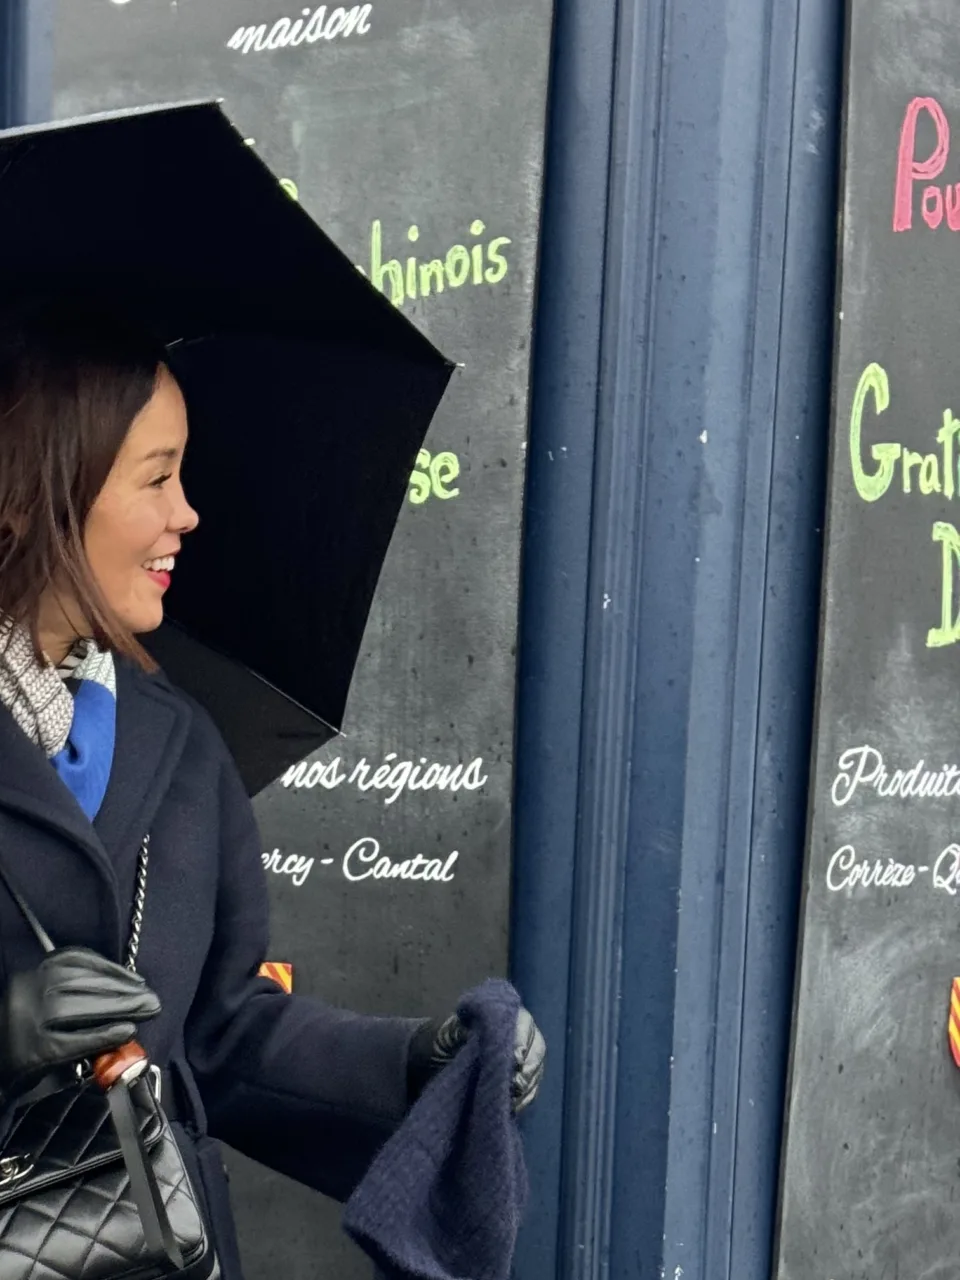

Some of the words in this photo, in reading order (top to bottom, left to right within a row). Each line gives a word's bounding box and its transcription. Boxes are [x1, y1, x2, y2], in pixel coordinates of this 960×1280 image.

[226, 3, 373, 54] maison
[356, 219, 512, 308] hinois
[280, 756, 346, 790] nos
[348, 752, 488, 805] régions
[830, 744, 960, 808] Produit
[342, 837, 459, 882] Cantal
[932, 842, 960, 896] Q
